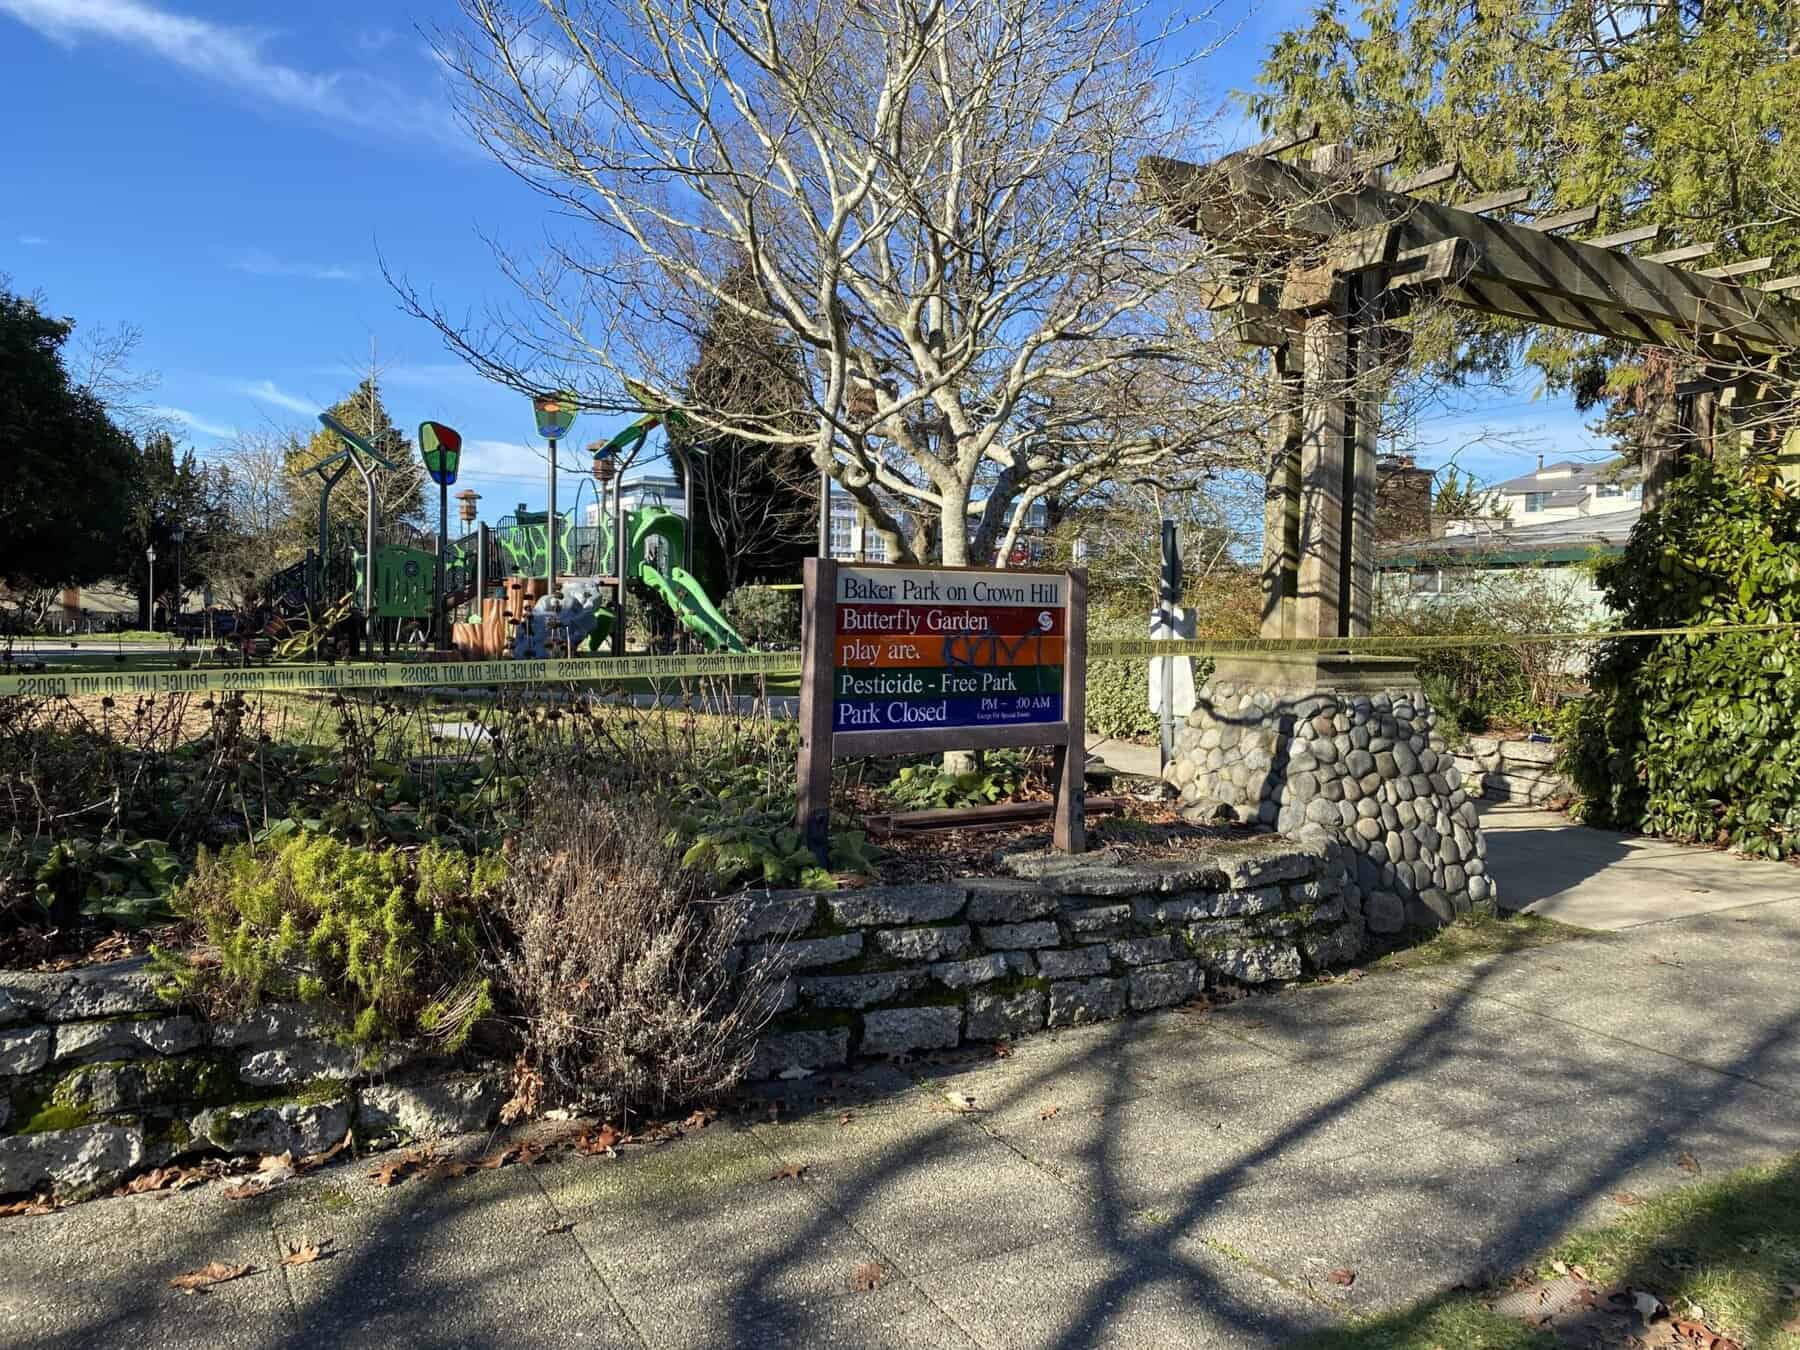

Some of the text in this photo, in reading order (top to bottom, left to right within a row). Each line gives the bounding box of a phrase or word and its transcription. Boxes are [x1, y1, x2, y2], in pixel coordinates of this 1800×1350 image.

[845, 578, 1058, 603] Baker Park on Crown Hill
[842, 608, 988, 635] Butterfly Garden
[841, 639, 881, 666] play
[841, 672, 923, 694] Pesticide
[941, 673, 977, 692] Free
[982, 671, 1017, 692] Park
[839, 700, 947, 725] Park Closed
[981, 698, 998, 710] PM
[1032, 696, 1051, 709] AM
